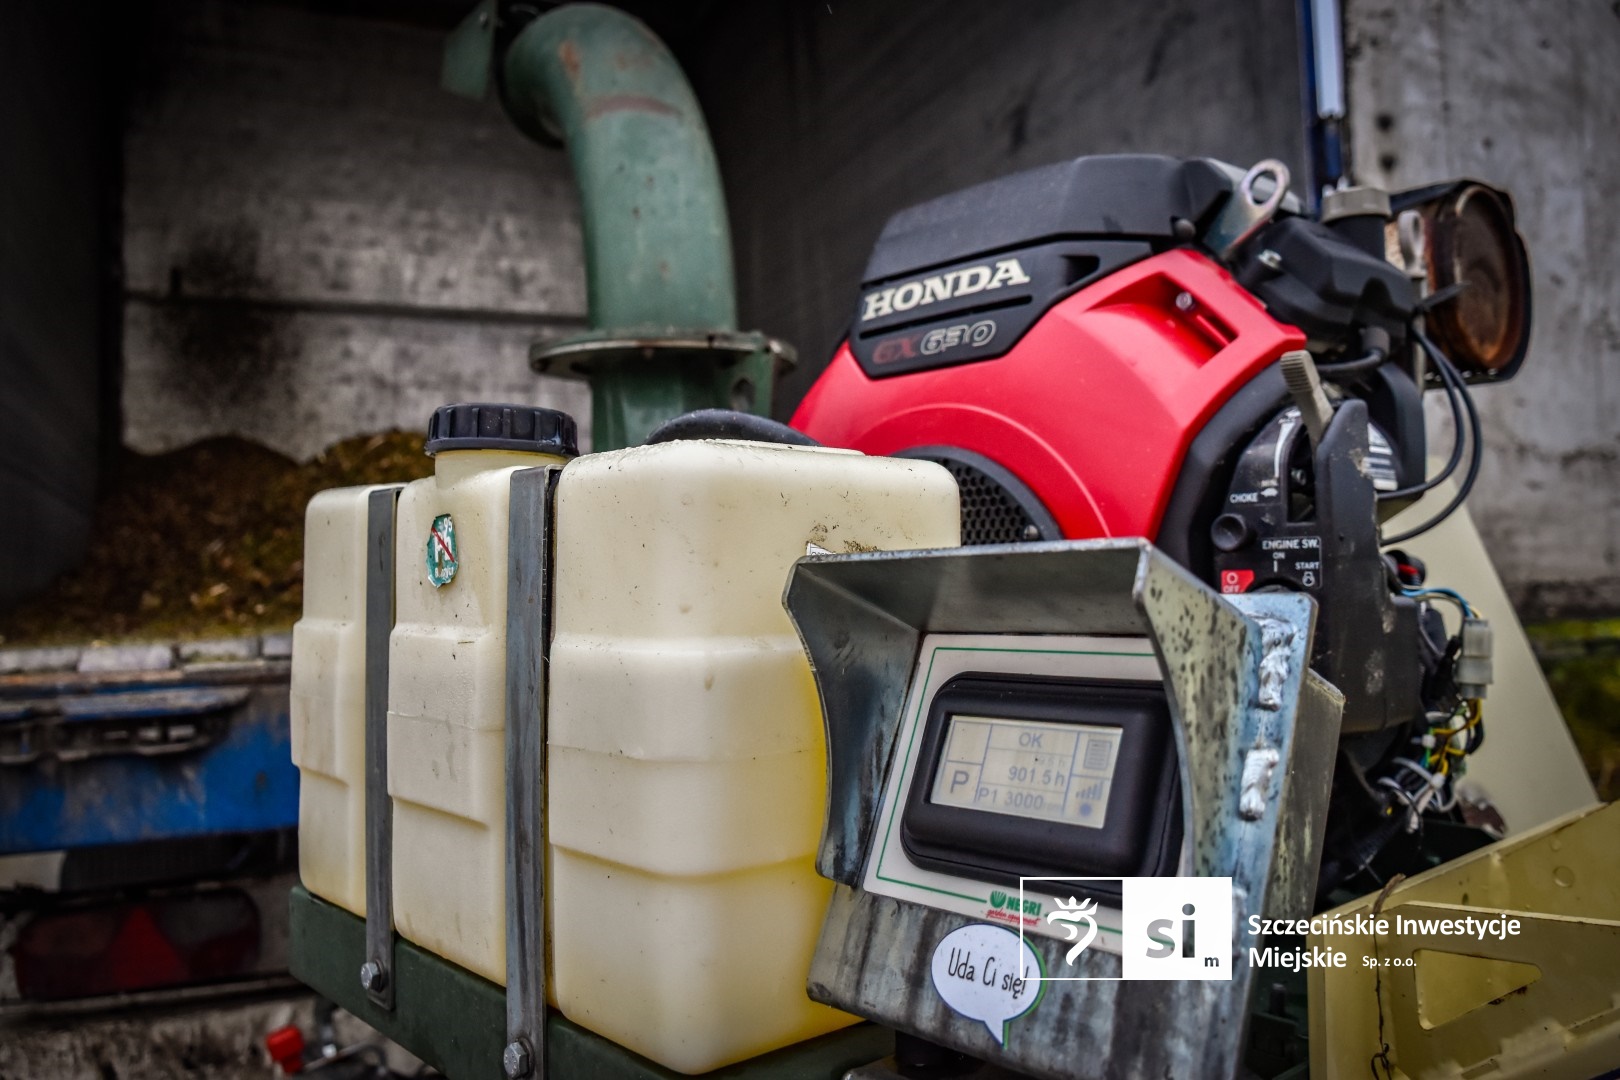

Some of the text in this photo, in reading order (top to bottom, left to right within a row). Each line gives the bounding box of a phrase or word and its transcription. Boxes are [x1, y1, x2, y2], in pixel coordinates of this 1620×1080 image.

[862, 258, 1031, 321] HONDA
[1230, 492, 1259, 503] CHOKE
[1262, 539, 1320, 550] ENGINE SW.
[1295, 562, 1319, 570] START
[1018, 732, 1043, 749] OK
[950, 770, 970, 794] P
[1054, 770, 1065, 787] h
[977, 788, 998, 804] P1
[1004, 792, 1045, 810] 3000
[1006, 896, 1042, 917] NEGRI
[948, 947, 1029, 1000] Uda Ci się!
